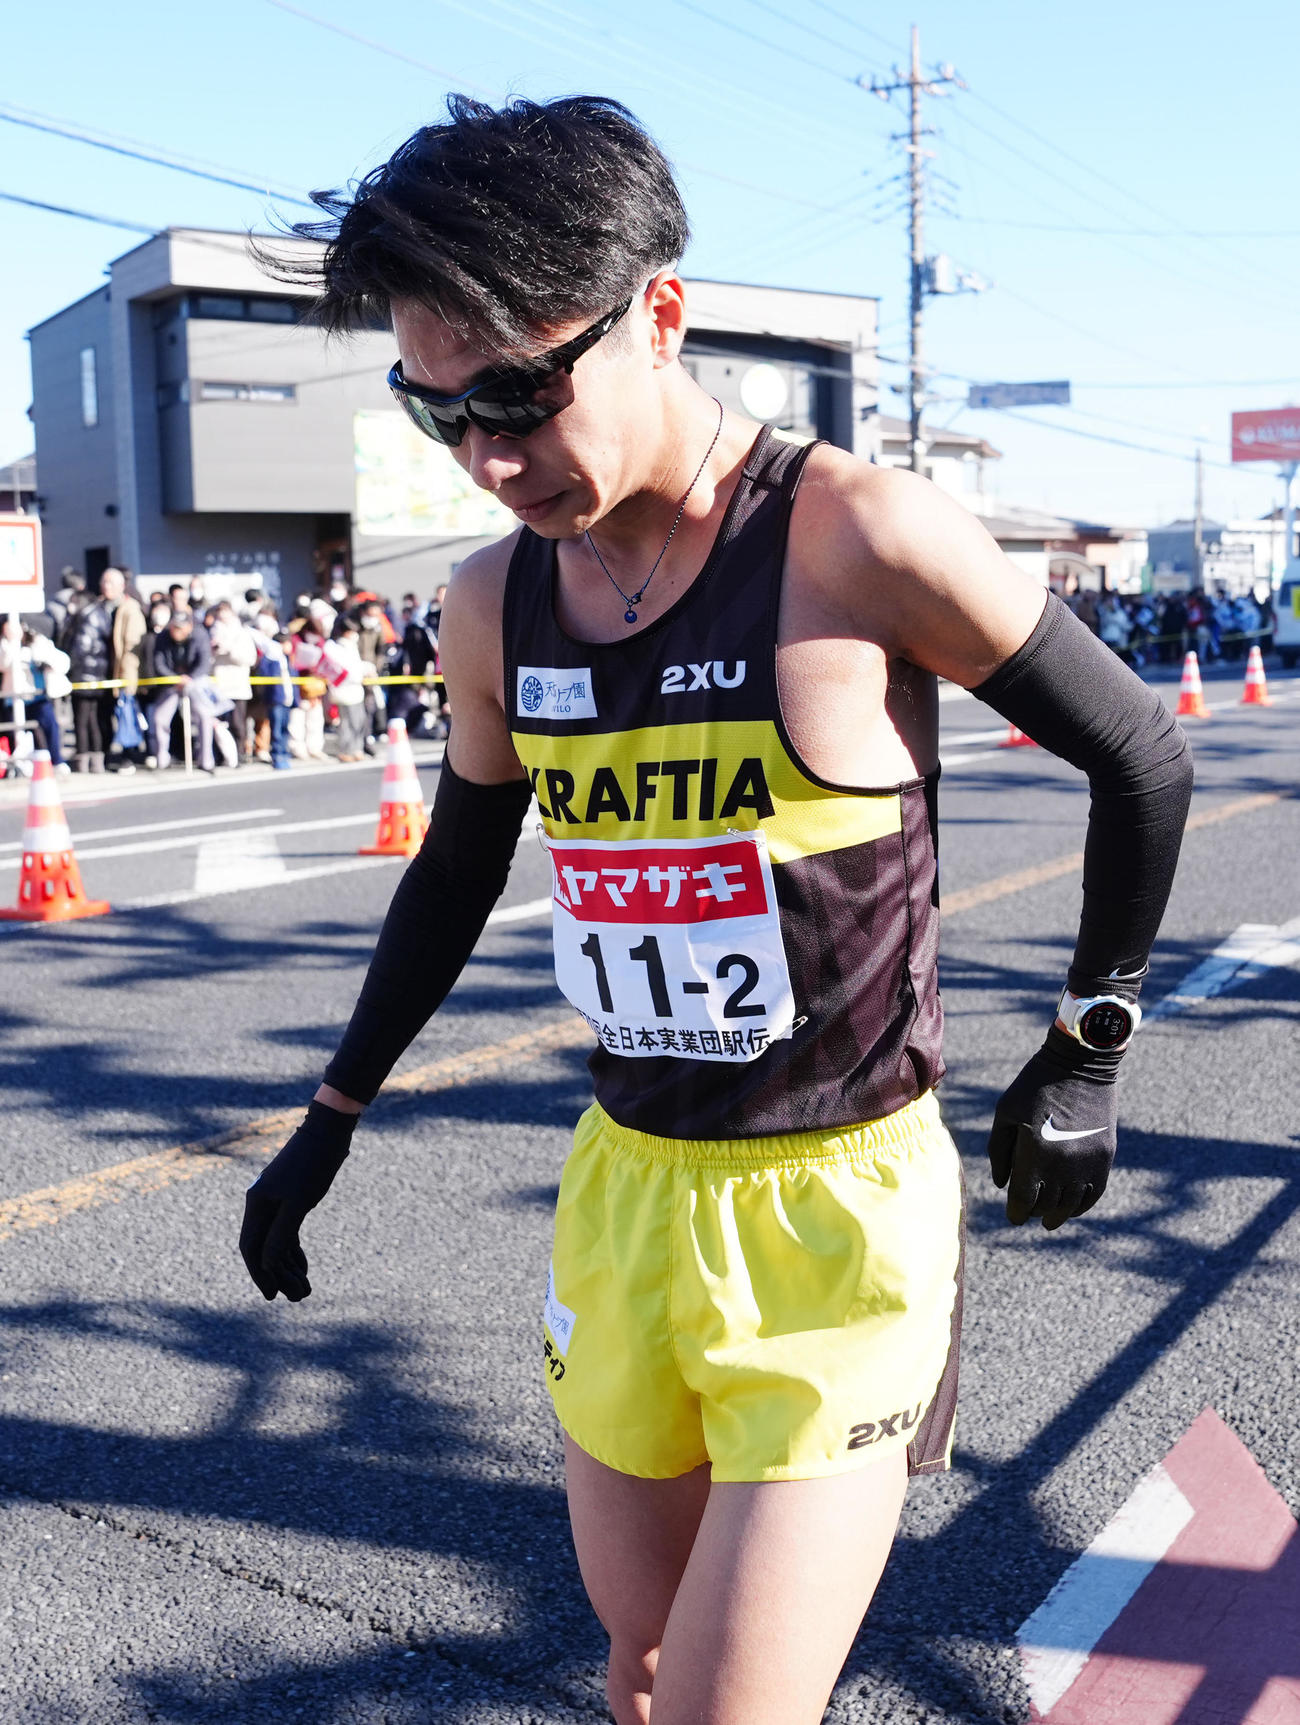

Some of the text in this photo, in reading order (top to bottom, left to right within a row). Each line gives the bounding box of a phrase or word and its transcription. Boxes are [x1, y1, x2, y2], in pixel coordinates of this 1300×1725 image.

[660, 660, 747, 695] 2XU
[523, 757, 776, 824] KRAFTIA
[560, 862, 747, 907] ヤマザキ
[580, 932, 767, 1019] 11-2
[580, 1009, 771, 1056] 全日本実業団駅伝
[846, 1400, 922, 1451] 2XU
